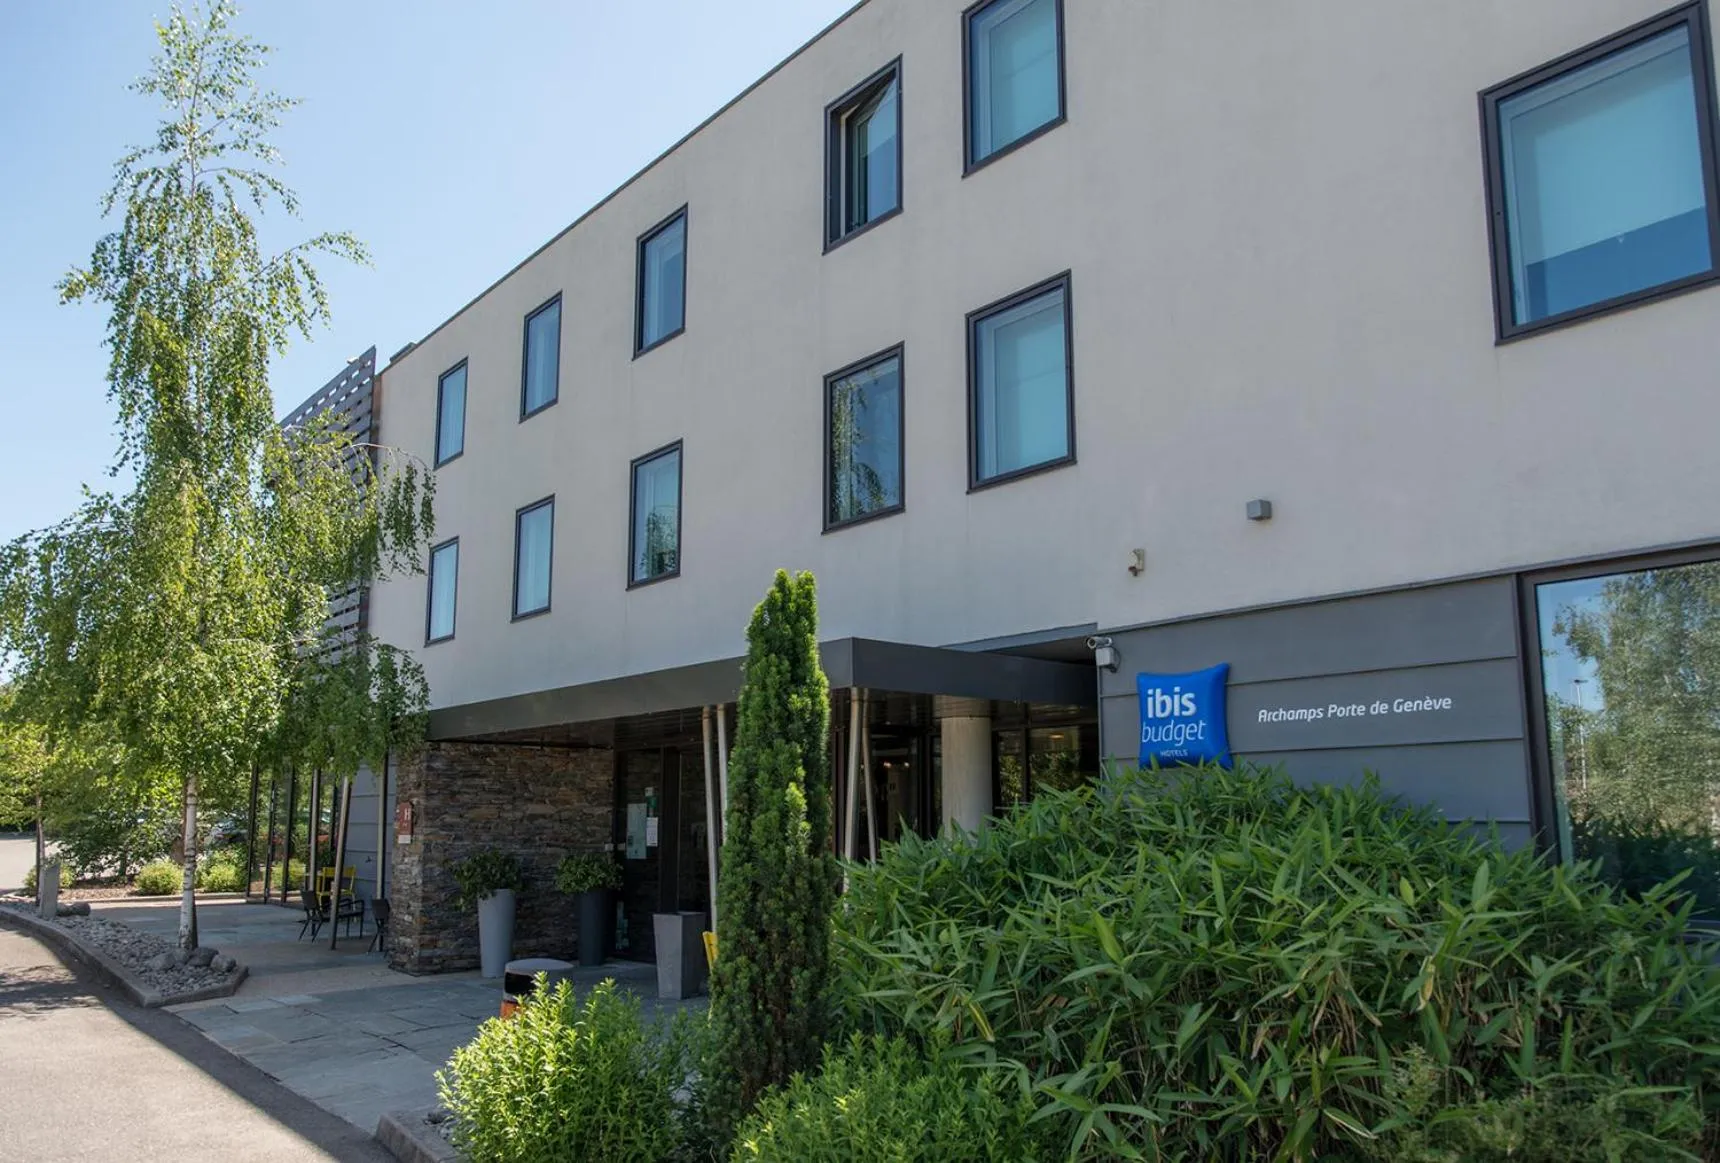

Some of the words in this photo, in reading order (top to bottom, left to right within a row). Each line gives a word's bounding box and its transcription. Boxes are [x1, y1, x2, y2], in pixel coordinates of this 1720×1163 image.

[1147, 686, 1197, 718] ibis
[1258, 707, 1325, 722] Archamps
[1327, 703, 1366, 718] Porte
[1370, 700, 1389, 715] de
[1393, 695, 1452, 713] Genève
[1141, 719, 1208, 747] budget
[1161, 749, 1189, 757] HOTELS
